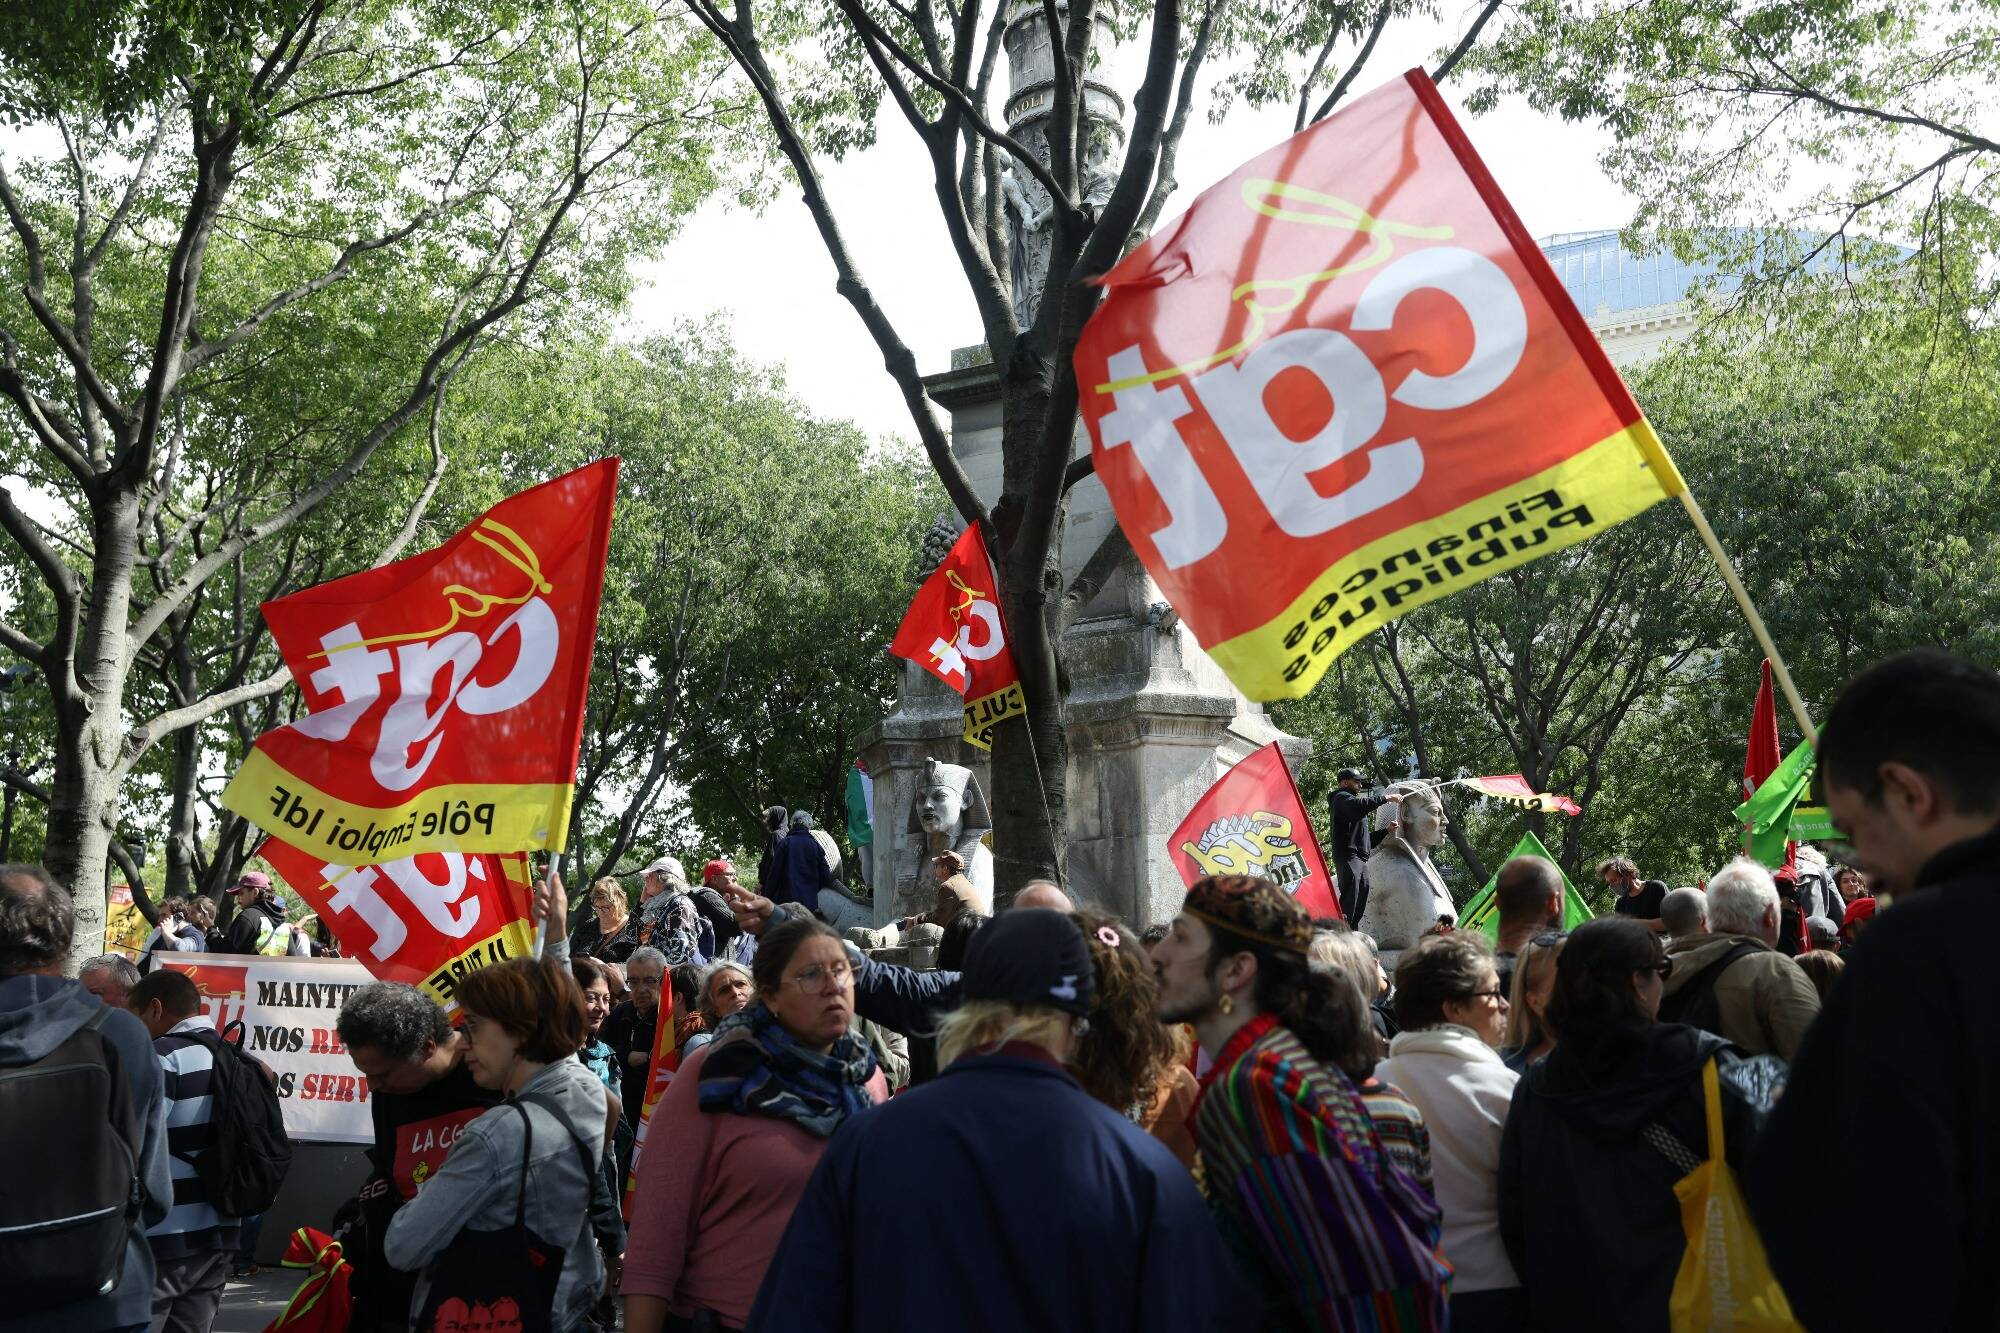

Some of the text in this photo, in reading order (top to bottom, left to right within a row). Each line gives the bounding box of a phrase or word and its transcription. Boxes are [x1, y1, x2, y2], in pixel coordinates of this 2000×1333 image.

[249, 1025, 348, 1055] NOS RE
[411, 1123, 465, 1153] LA CG
